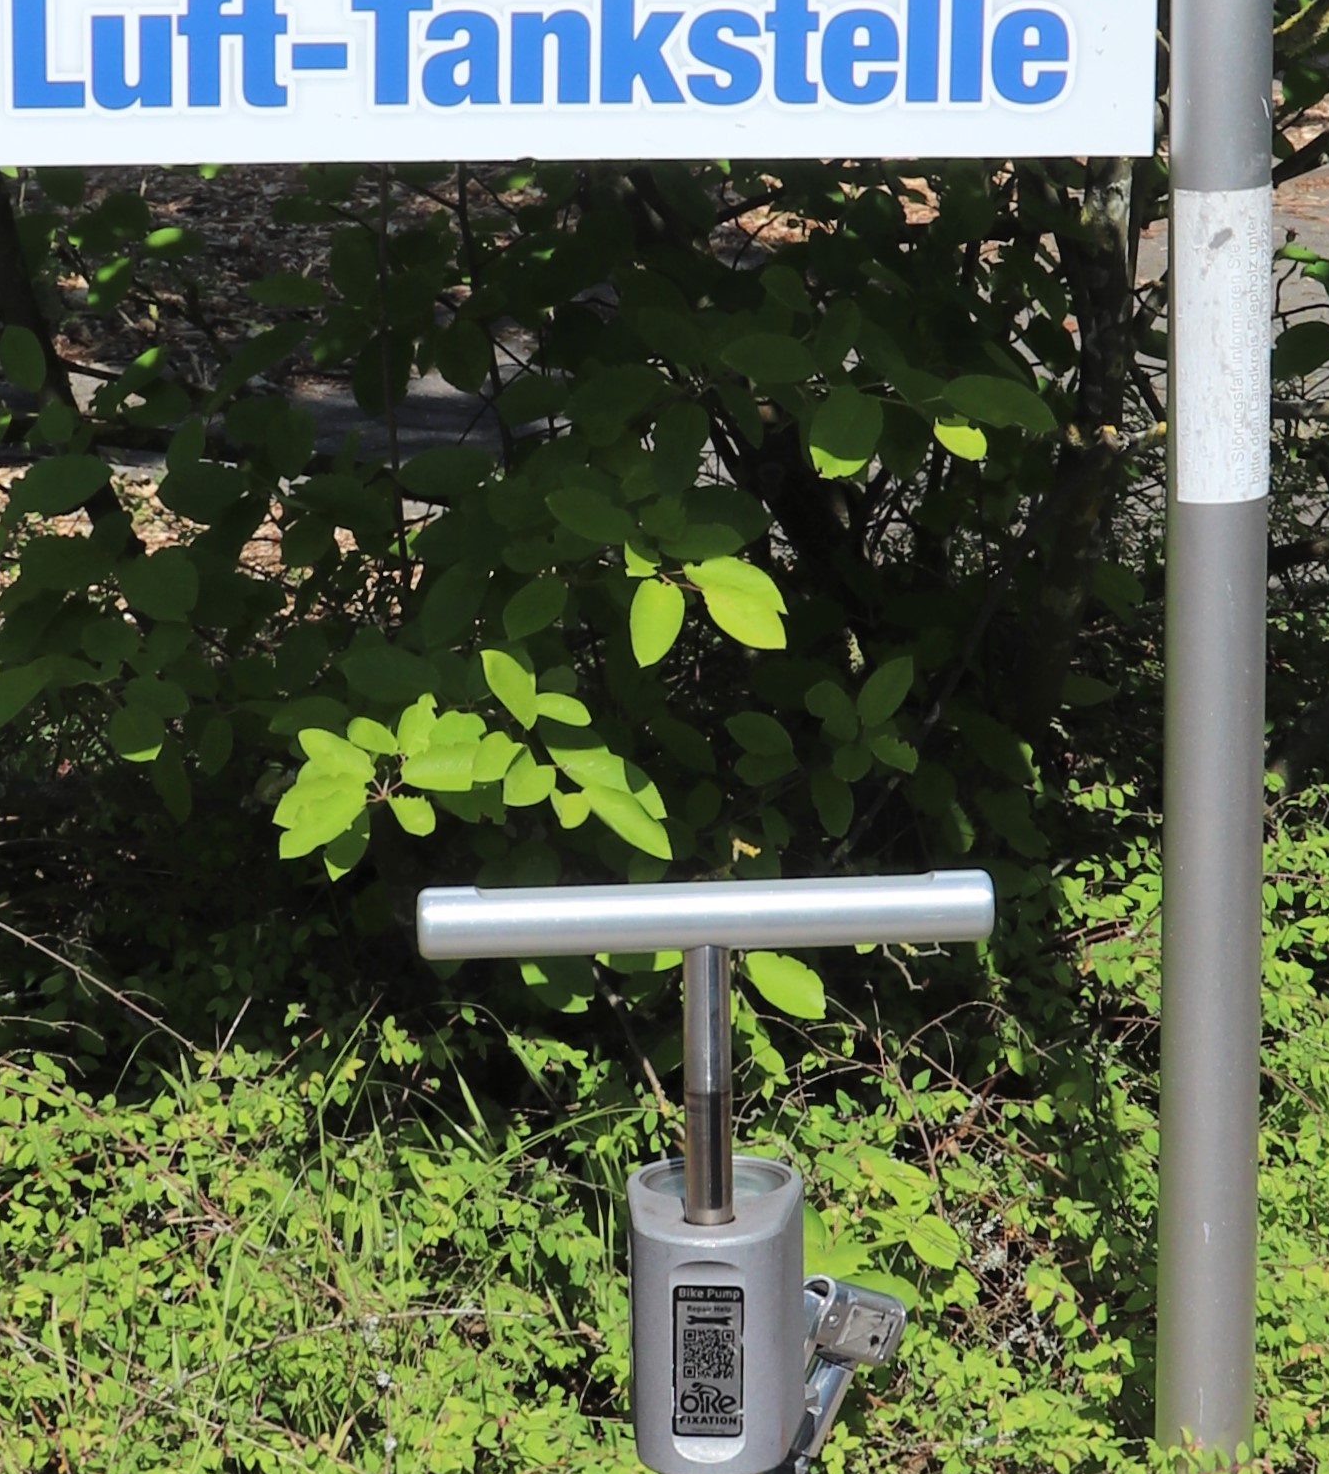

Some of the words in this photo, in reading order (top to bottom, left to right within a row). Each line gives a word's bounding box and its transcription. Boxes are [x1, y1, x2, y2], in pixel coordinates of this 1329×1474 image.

[1246, 215, 1258, 255] unter
[1228, 243, 1241, 269] Sie
[1230, 276, 1243, 364] informieren
[1247, 336, 1260, 412] Landkreis
[1249, 416, 1260, 447] den
[1249, 452, 1260, 485] bitte
[678, 1287, 704, 1299] Bike
[707, 1288, 740, 1301] Pump
[680, 1416, 737, 1425] FIXATION
